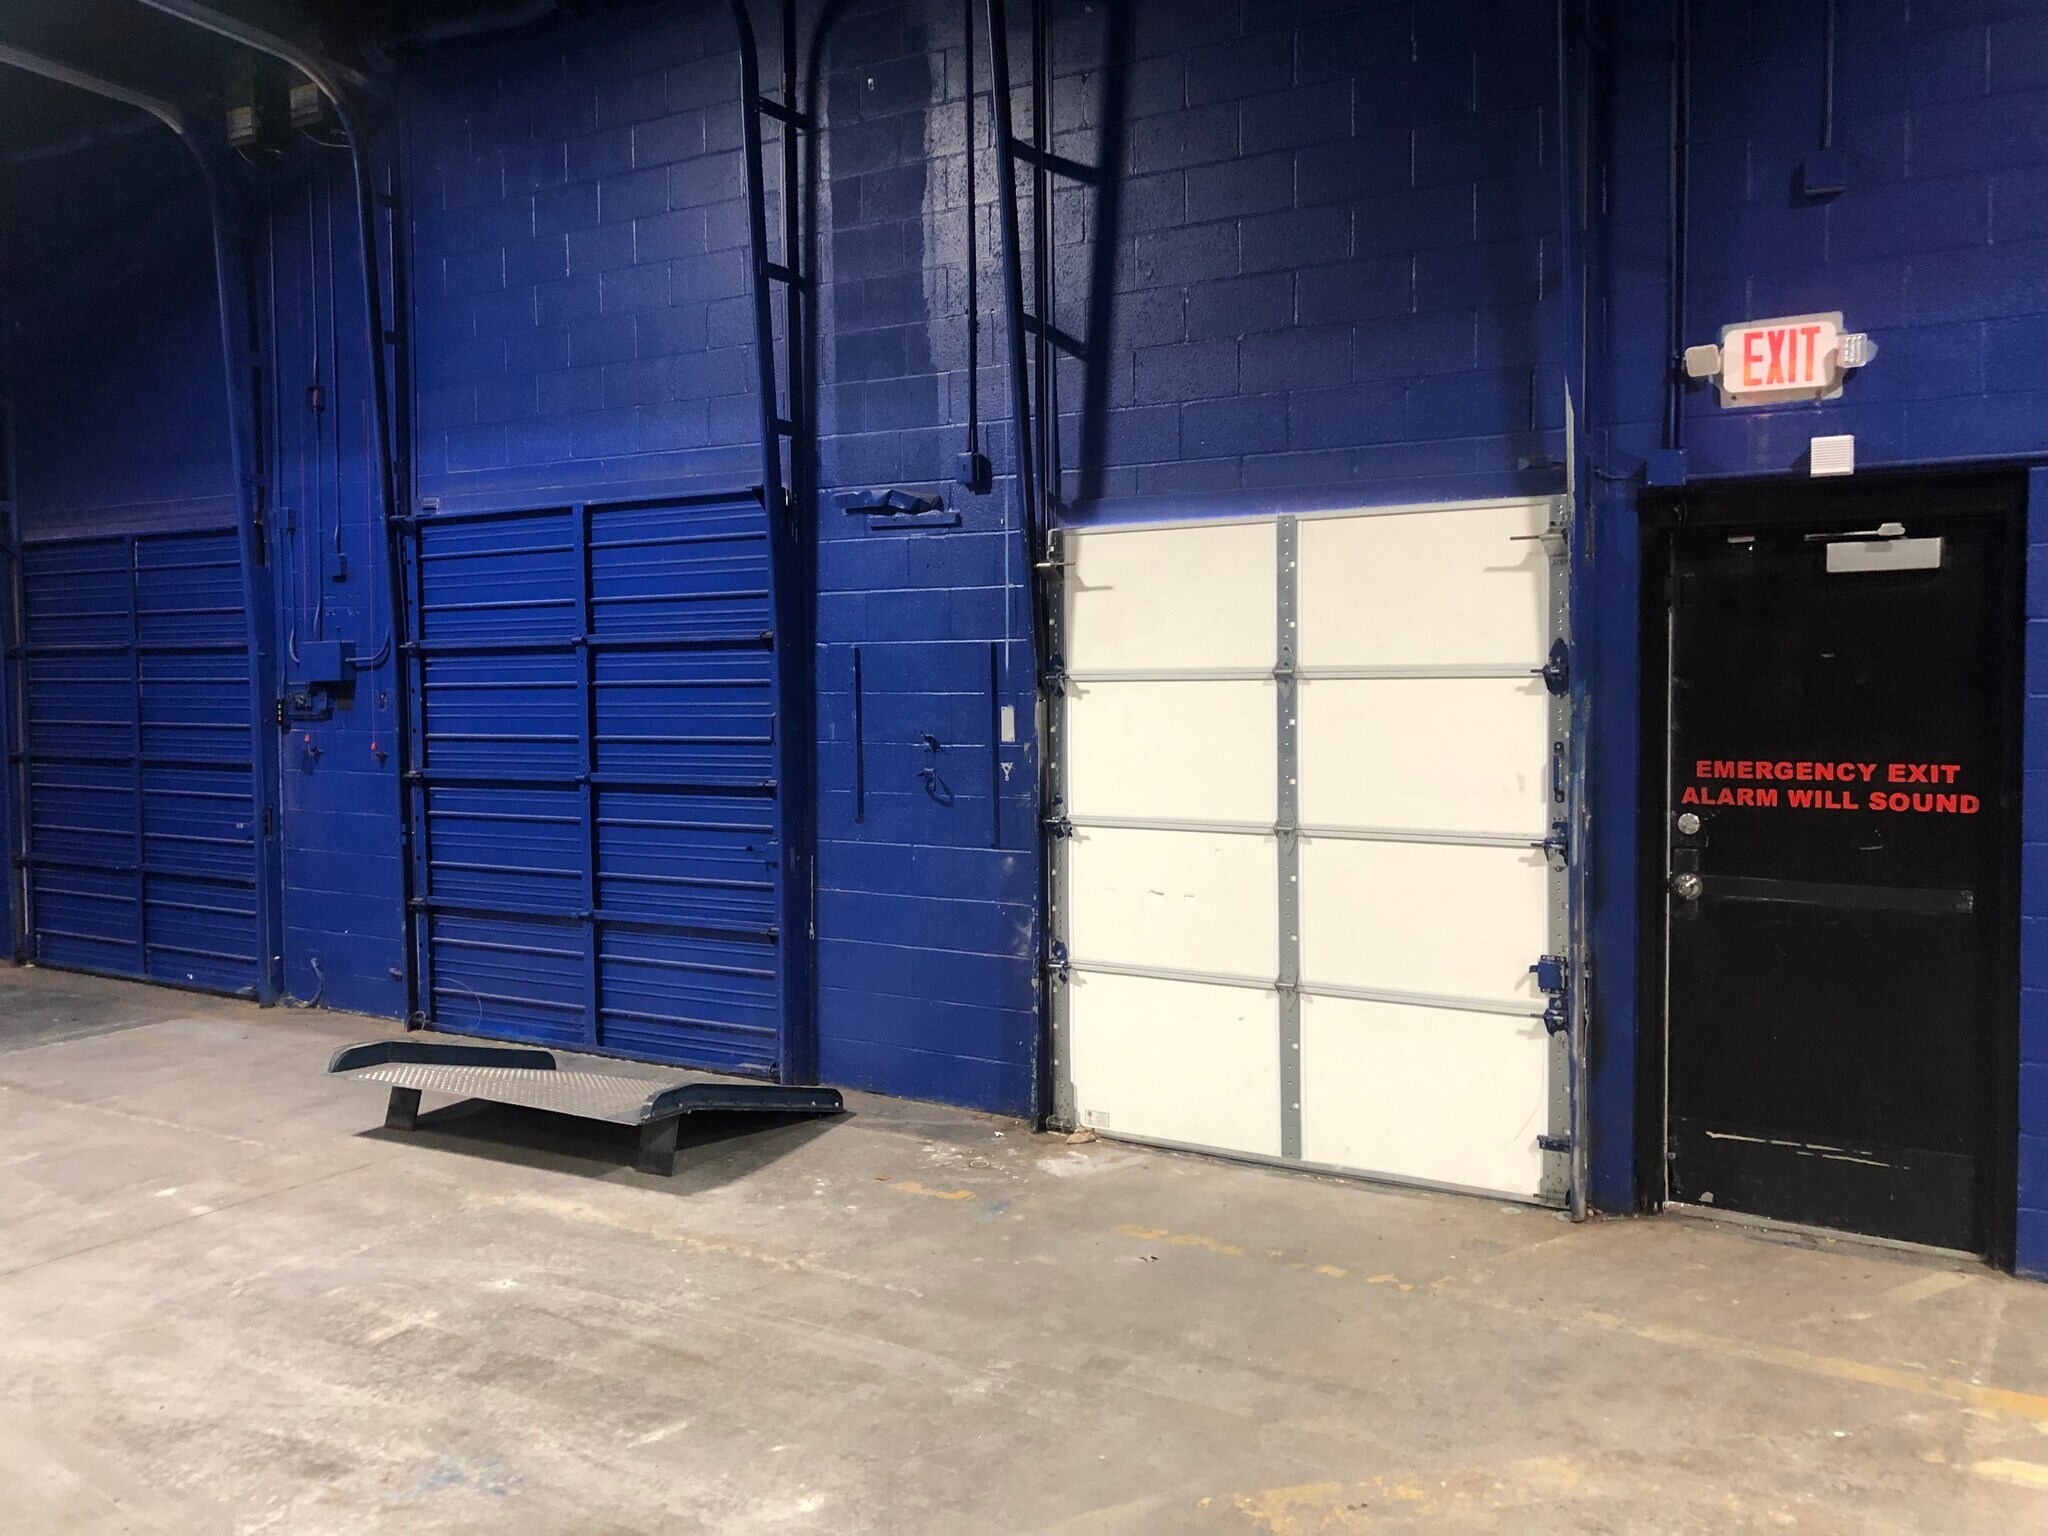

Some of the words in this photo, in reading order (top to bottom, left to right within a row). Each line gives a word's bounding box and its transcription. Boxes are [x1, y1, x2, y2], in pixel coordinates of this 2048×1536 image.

[1743, 326, 1821, 387] EXIT
[1696, 760, 1877, 782] EMERGENCY
[1888, 763, 1961, 784] EXIT
[1681, 786, 1778, 807] ALARM
[1788, 789, 1859, 810] WILL
[1868, 791, 1980, 815] SOUND
